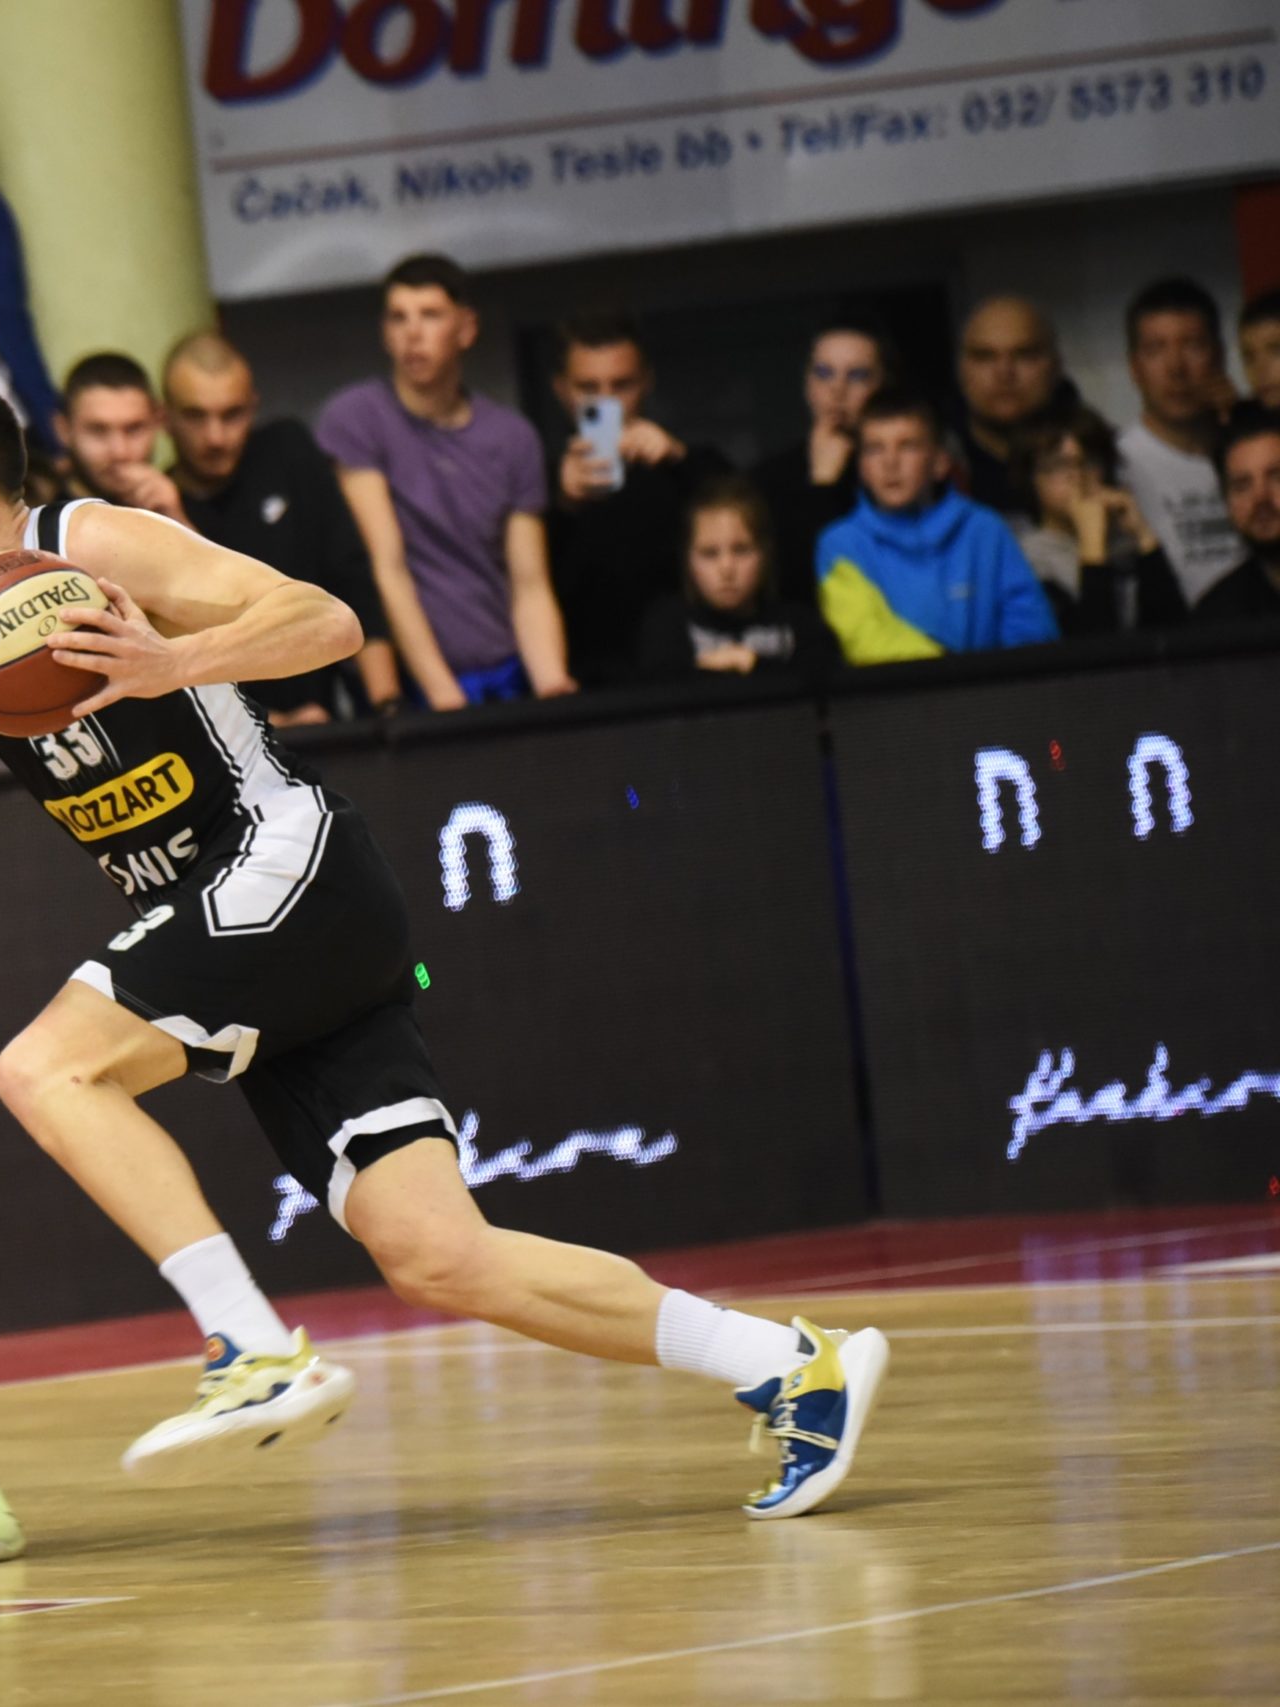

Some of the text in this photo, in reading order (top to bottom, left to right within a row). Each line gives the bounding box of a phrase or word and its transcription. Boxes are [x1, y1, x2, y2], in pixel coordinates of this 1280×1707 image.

[395, 155, 533, 201] Nikole
[547, 135, 663, 184] Tesle
[1186, 58, 1267, 108] 310
